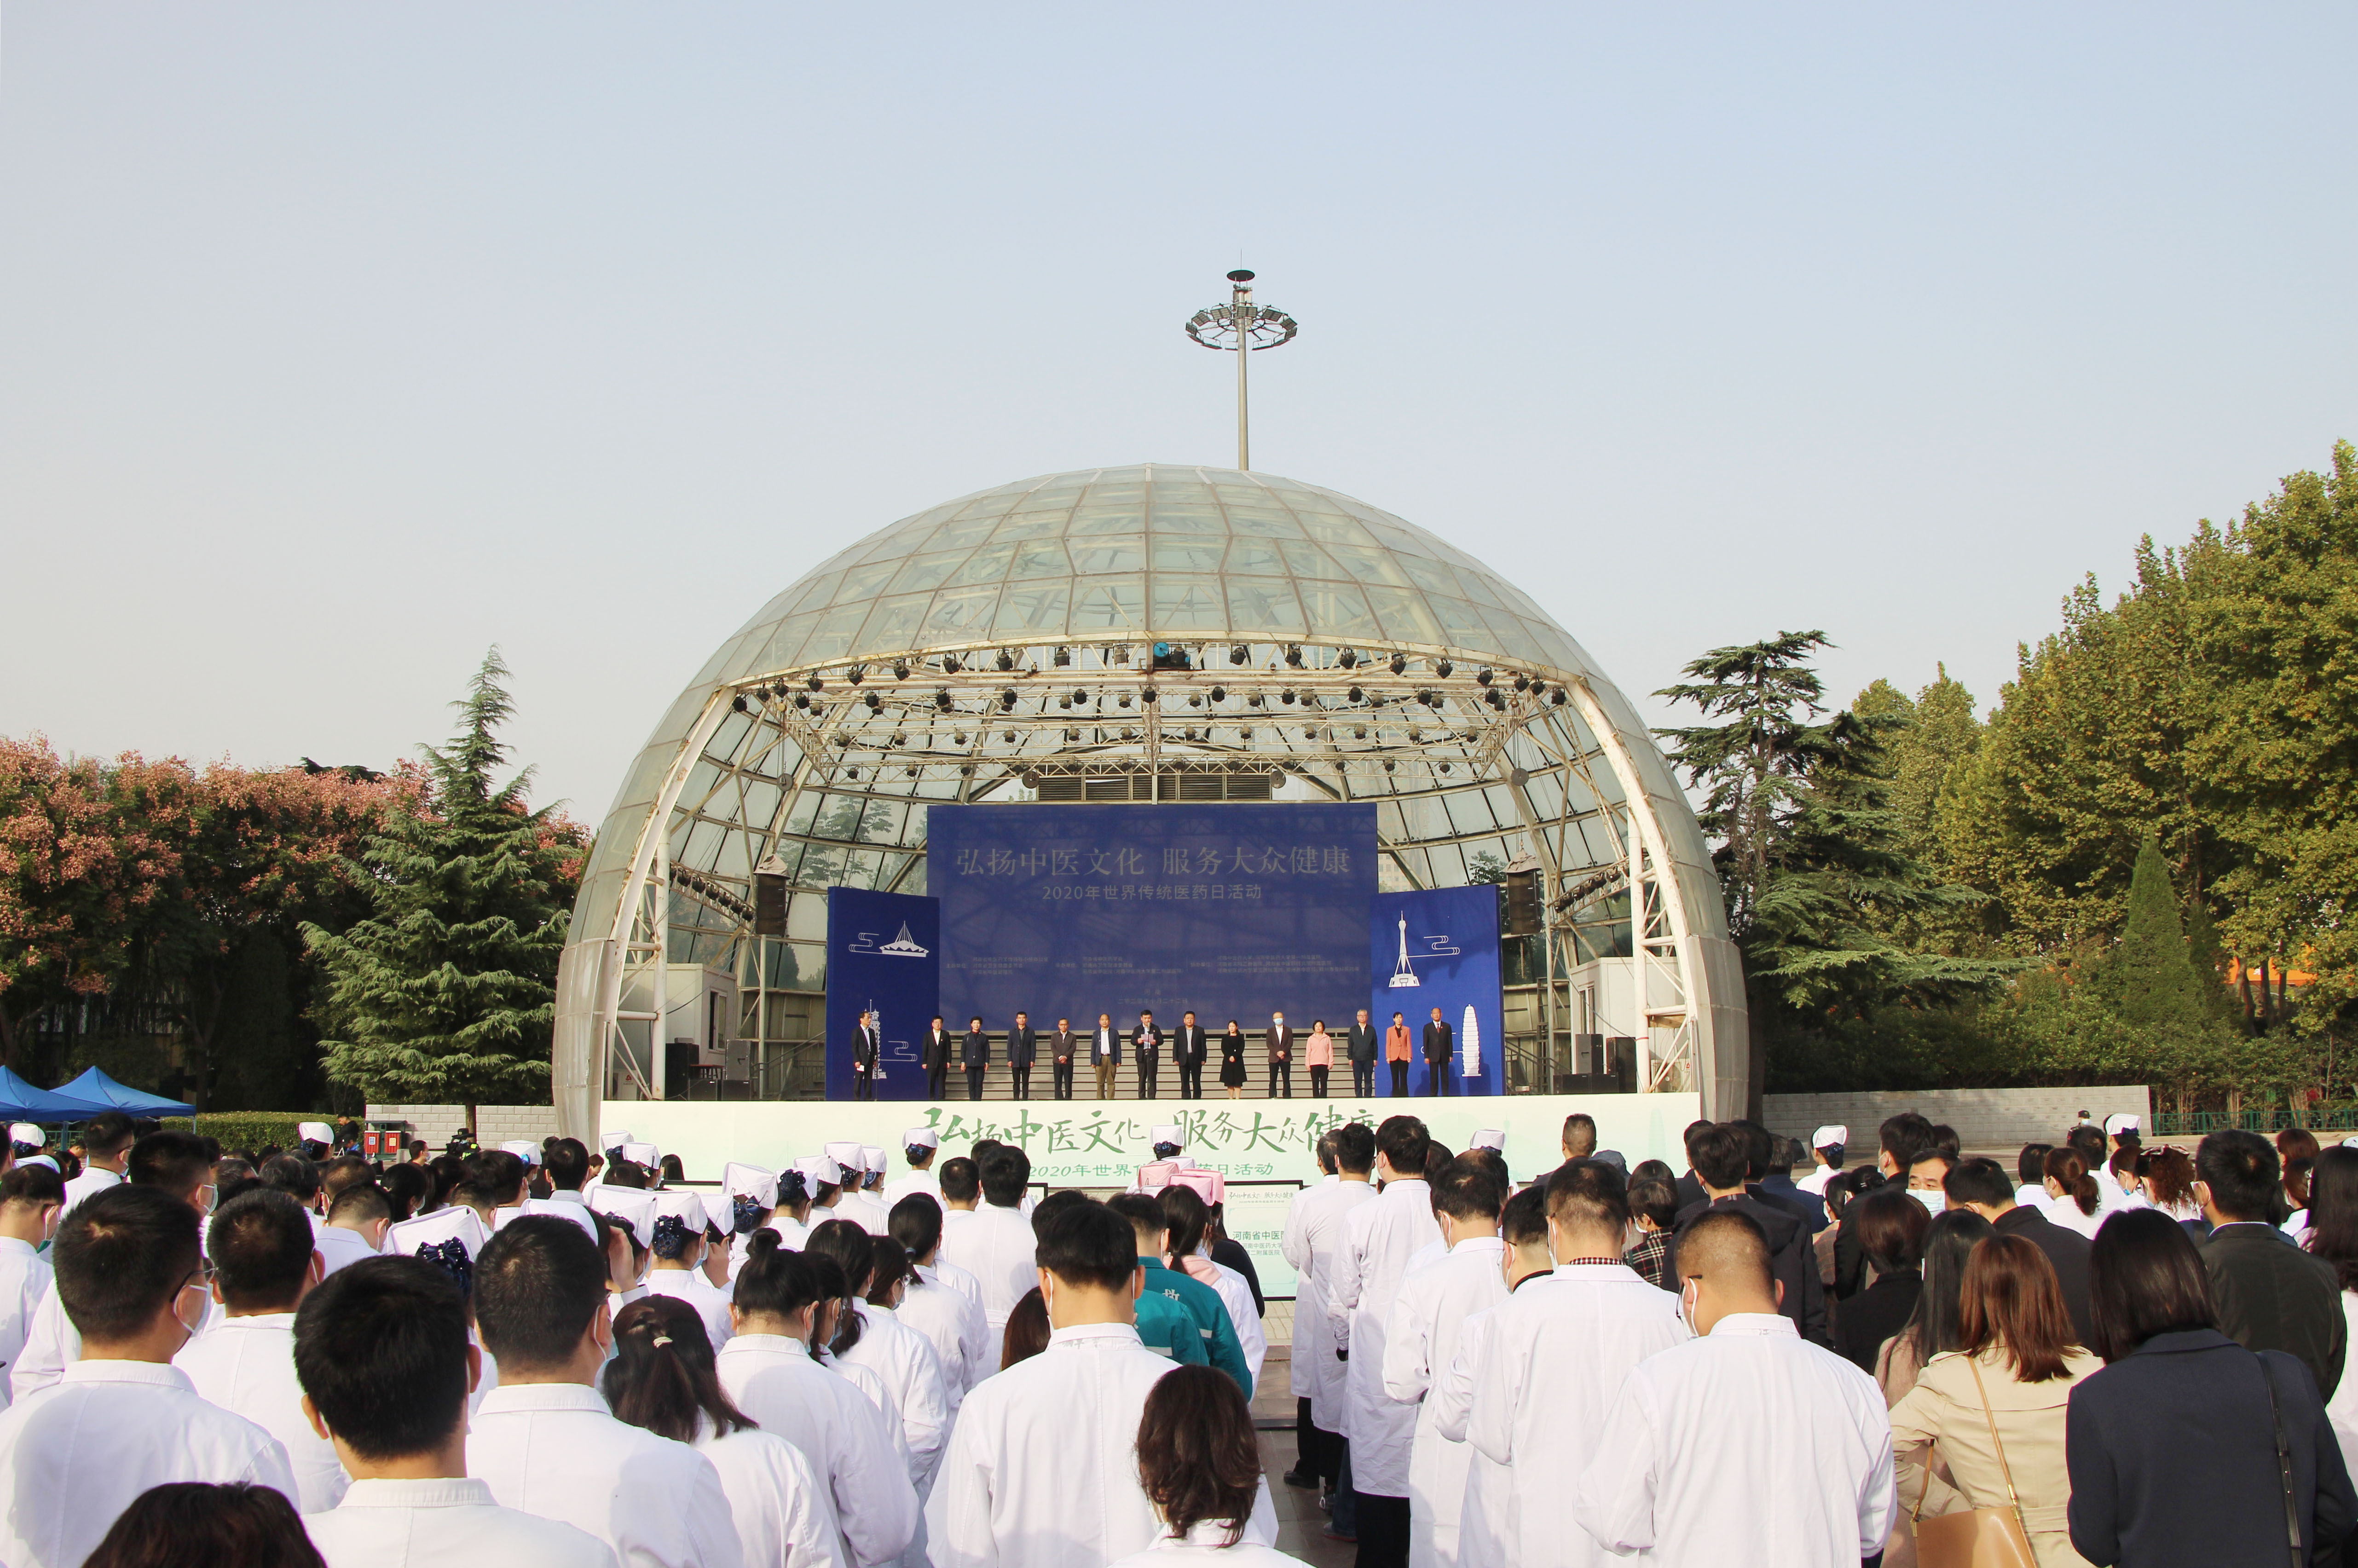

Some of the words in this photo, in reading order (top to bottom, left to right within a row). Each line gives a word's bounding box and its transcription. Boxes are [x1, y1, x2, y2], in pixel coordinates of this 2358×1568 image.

[957, 847, 1144, 876] 弘扬中医文化
[1162, 845, 1350, 875] 服务大众健康
[1042, 884, 1261, 901] 2020年世界传统医药日活动
